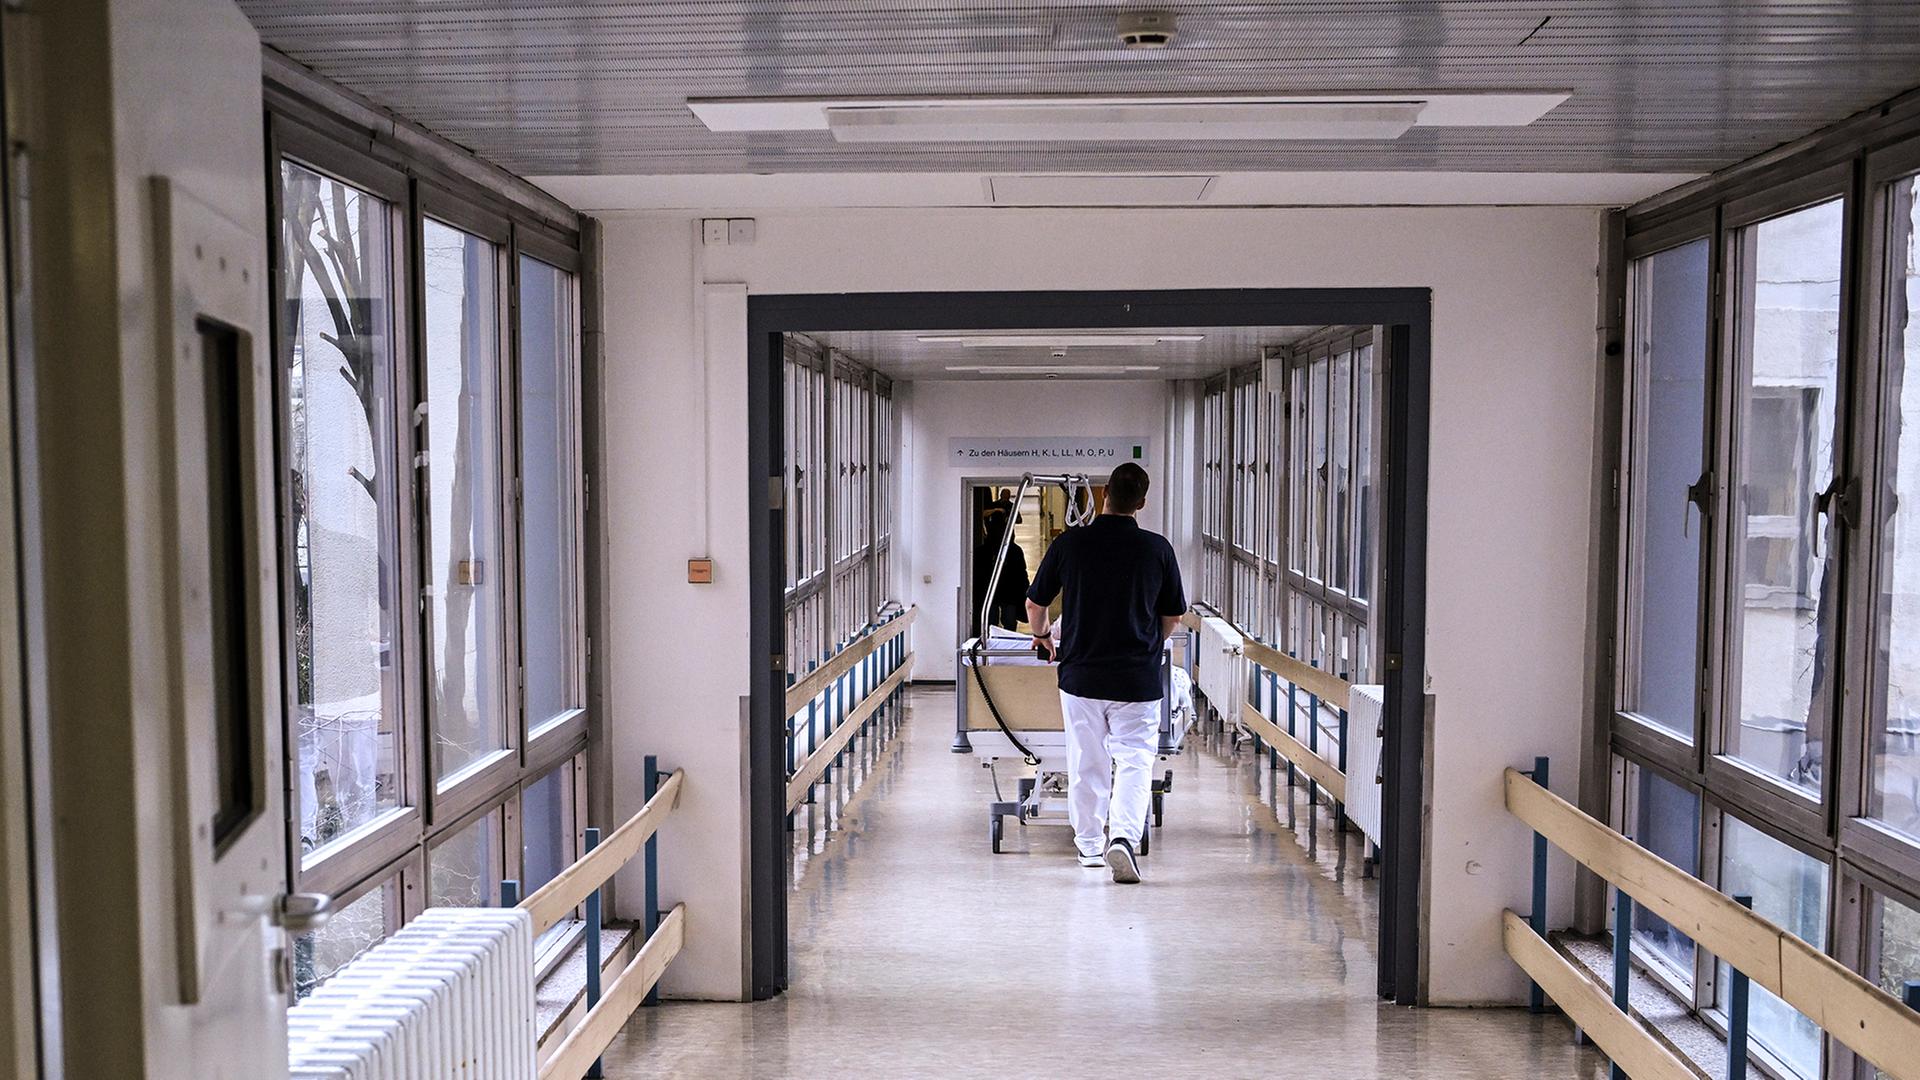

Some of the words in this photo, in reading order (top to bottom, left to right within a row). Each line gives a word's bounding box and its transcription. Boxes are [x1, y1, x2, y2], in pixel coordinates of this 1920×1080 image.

[969, 449, 979, 457] Zu
[981, 449, 996, 457] den
[997, 449, 1030, 457] Häusern
[1107, 449, 1115, 457] U
